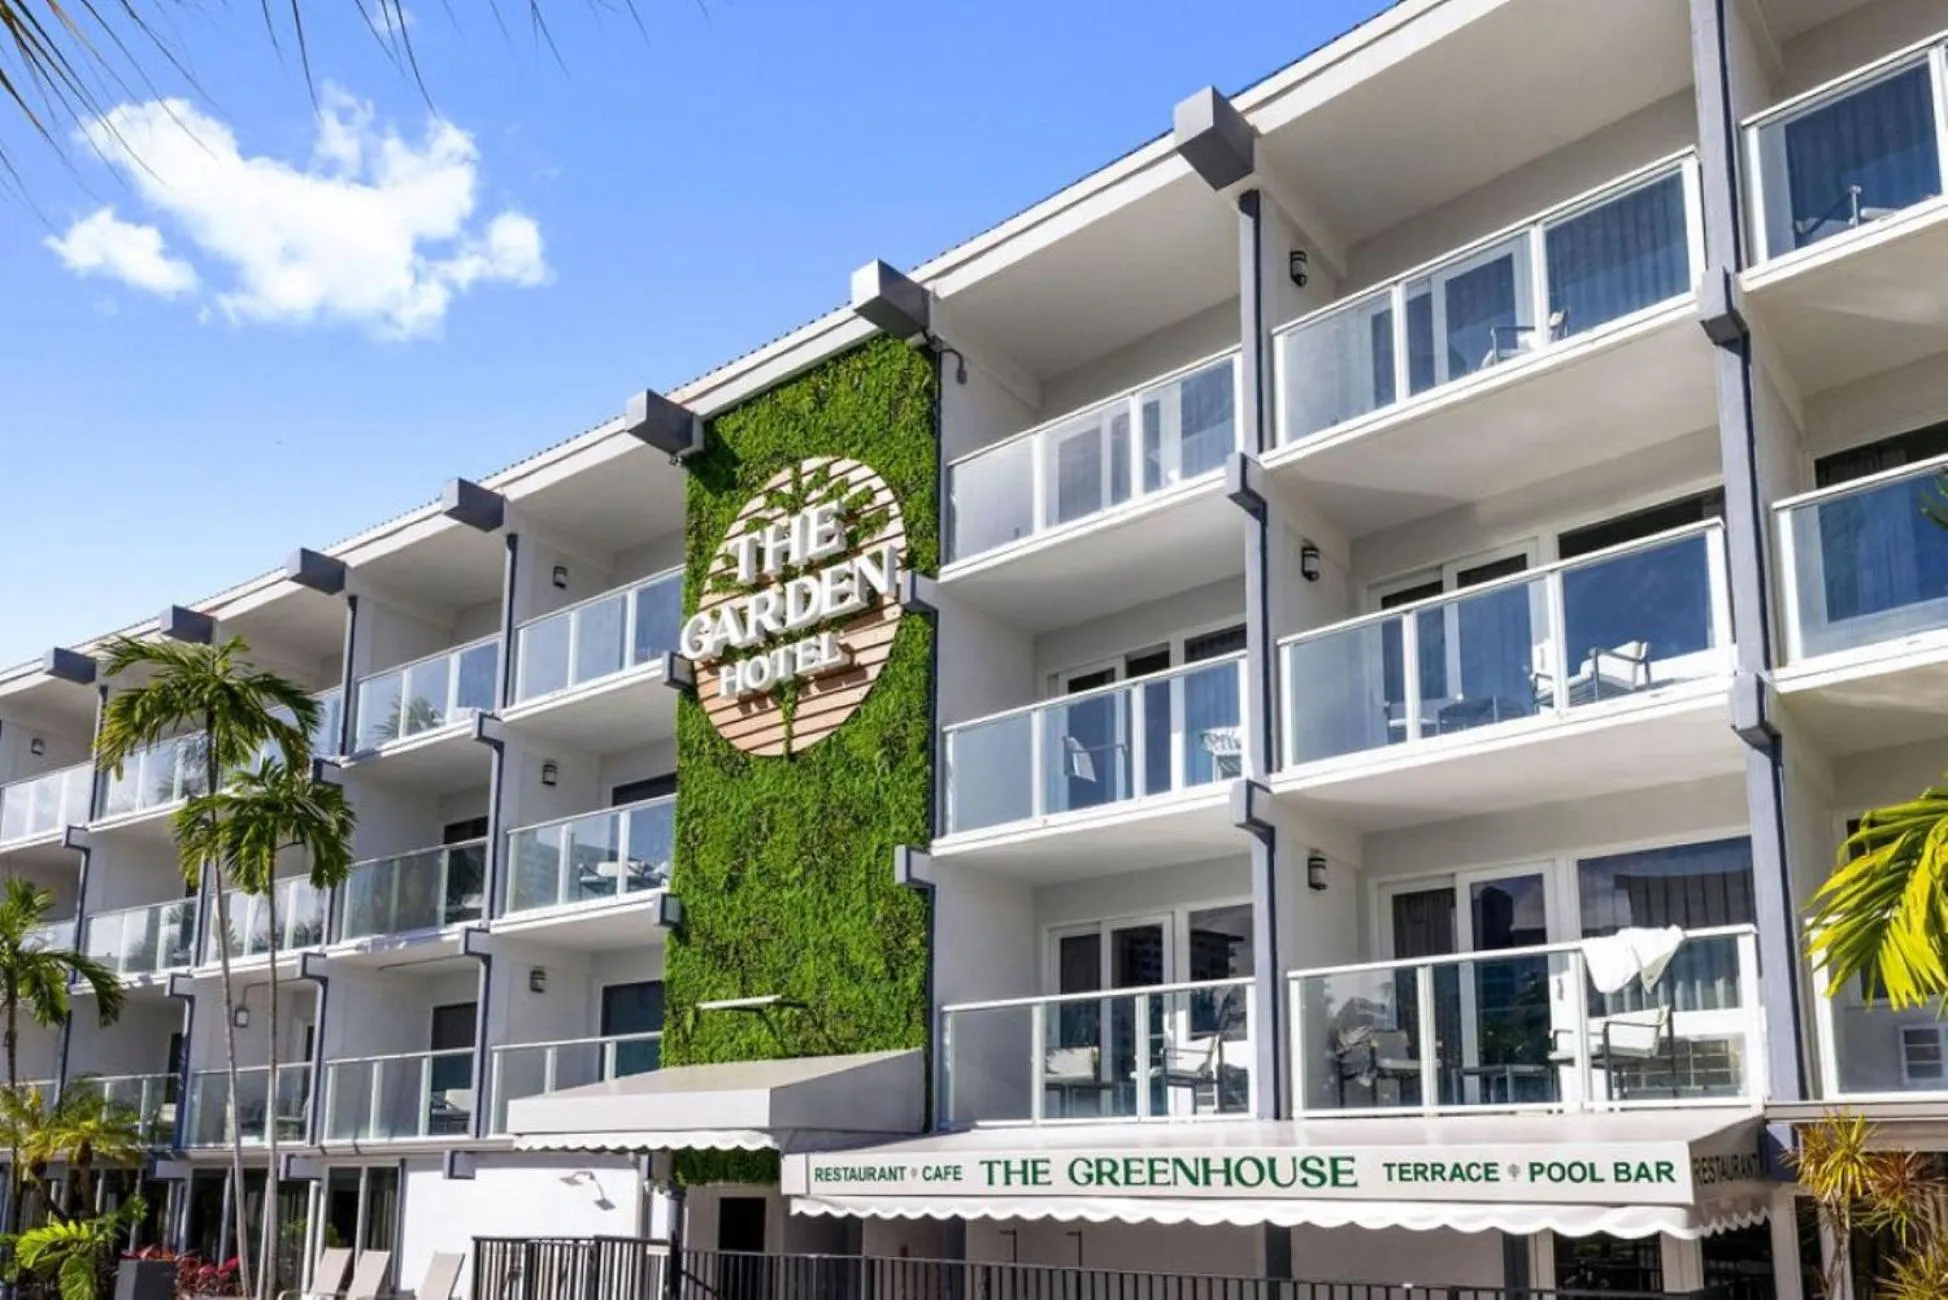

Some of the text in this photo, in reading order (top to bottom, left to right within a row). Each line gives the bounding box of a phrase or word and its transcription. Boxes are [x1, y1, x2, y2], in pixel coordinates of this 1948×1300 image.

[725, 499, 849, 585] THE
[680, 544, 902, 661] GARDEN
[717, 630, 846, 700] HOTEL
[814, 1155, 1676, 1189] RESTAURANT CAFE THE GREENHOUSE TERRACE POOL BAR
